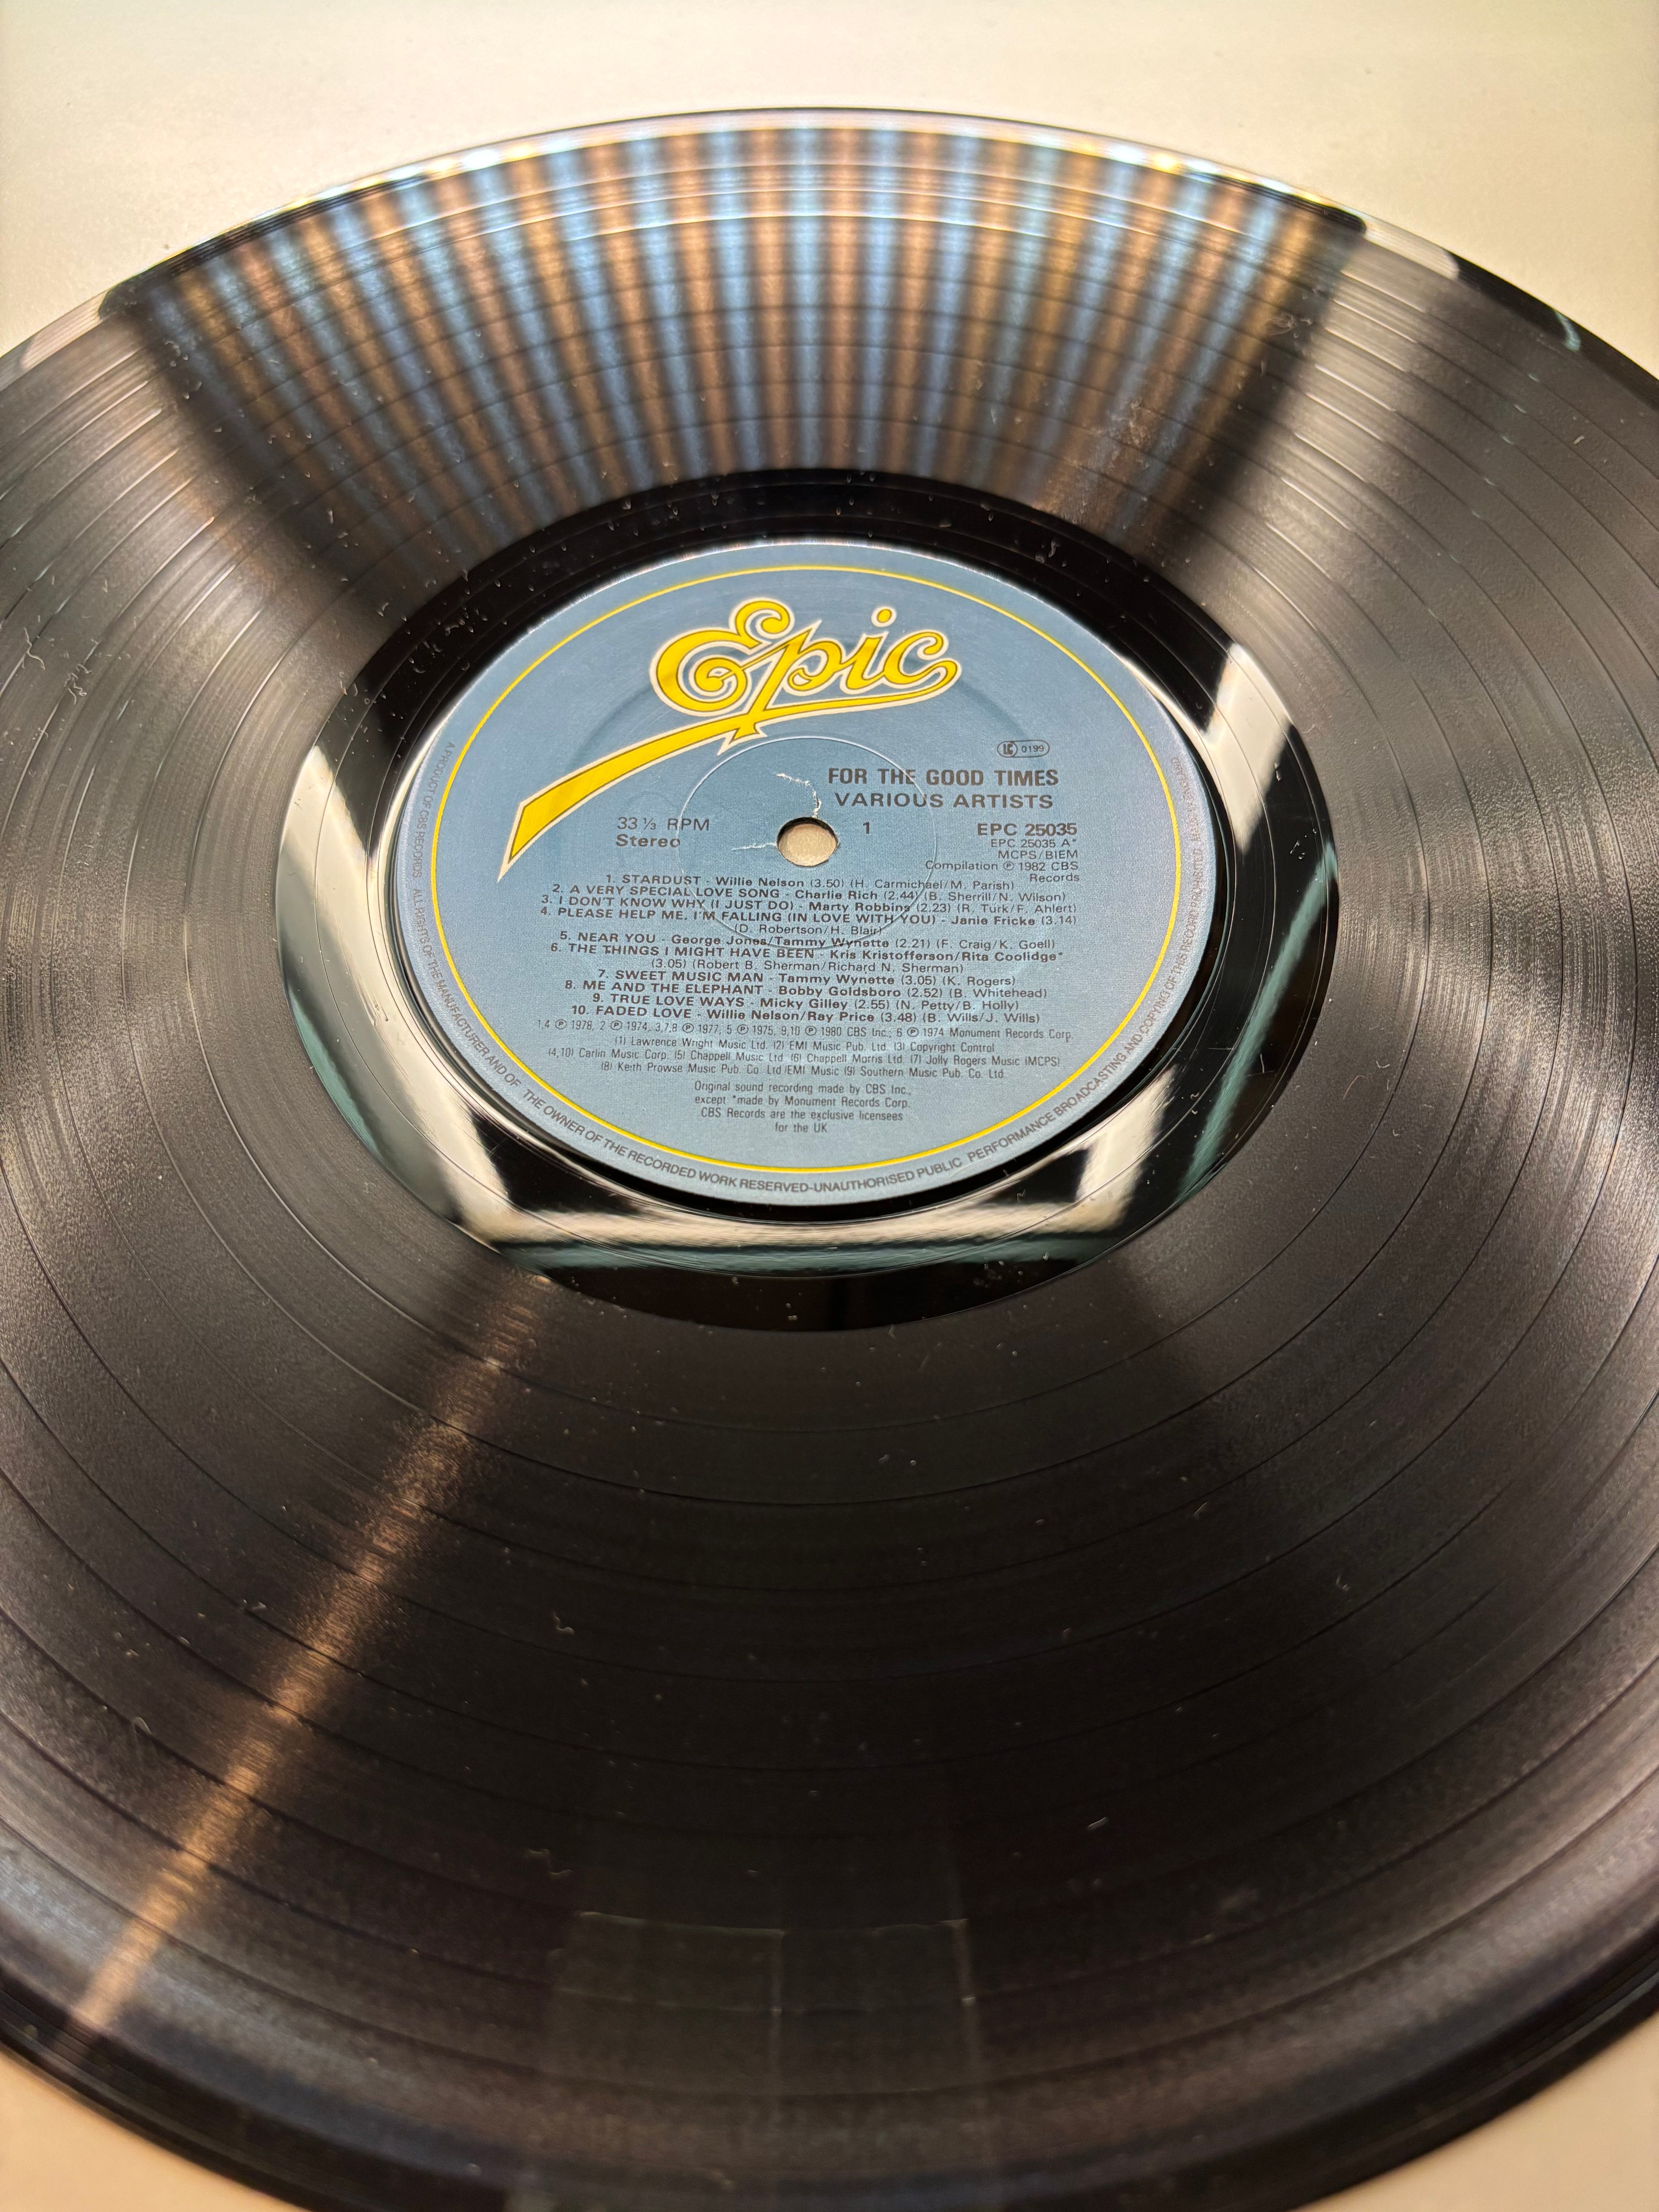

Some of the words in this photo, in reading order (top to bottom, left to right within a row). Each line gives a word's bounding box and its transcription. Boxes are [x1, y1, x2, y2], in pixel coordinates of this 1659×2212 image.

[1021, 745, 1045, 754] 0199
[429, 750, 452, 795] PRODUCT
[829, 768, 867, 785] FOR
[878, 769, 915, 785] THE
[926, 769, 984, 786] GOOD
[995, 769, 1058, 787] TIMES
[422, 795, 434, 812] OF
[835, 793, 944, 807] VARIOUS
[953, 794, 1053, 809] ARTISTS
[667, 818, 710, 831] RPM
[863, 822, 871, 834] 1
[977, 823, 1017, 836] EPC
[1025, 823, 1077, 836] 25035
[616, 834, 681, 848] Stereo
[991, 839, 1017, 848] EPC
[1021, 839, 1056, 848] 25035
[998, 850, 1078, 860] MCPS/BIEM
[925, 861, 998, 871] Compilation
[1019, 861, 1046, 871] 1982
[1051, 861, 1079, 871] CBS
[623, 875, 701, 885] STARDUST
[716, 877, 752, 886] Willie
[758, 878, 804, 887] Nelson
[810, 879, 844, 888] (3.50)
[973, 880, 1014, 890] Parish)
[1030, 873, 1080, 883] Records
[570, 885, 580, 894] A
[587, 886, 624, 895] VERY
[630, 887, 691, 896] SPECIAL
[697, 888, 733, 897] LOVE
[738, 889, 779, 898] SONG
[795, 890, 842, 899] Charlie
[849, 891, 877, 899] Rich
[884, 892, 918, 900] (2.44)
[1019, 893, 1065, 902] Wilson)
[558, 908, 613, 918] PLEASE
[619, 909, 656, 919] HELP
[721, 912, 782, 922] FALLING
[788, 913, 807, 922] (IN
[814, 914, 850, 923] LOVE
[855, 914, 893, 924] WITH
[900, 915, 935, 925] YOU)
[951, 916, 988, 925] Janie
[994, 917, 1035, 926] Fricke
[1042, 916, 1077, 925] (3.14)
[578, 932, 619, 942] NEAR
[626, 934, 656, 943] YOU
[671, 935, 721, 945] George
[727, 936, 826, 947] Jones/Tammy
[832, 938, 889, 948] Wynette
[895, 939, 930, 948] (2.21)
[1019, 940, 1055, 950] Goell)
[423, 945, 435, 960] OF
[569, 944, 597, 953] THE
[603, 945, 659, 955] THINGS
[675, 947, 725, 957] MIGHT
[730, 948, 770, 958] HAVE
[777, 949, 814, 958] BEEN
[830, 950, 856, 959] Kris
[862, 951, 988, 962] Kristofferson/Rita
[428, 958, 444, 983] THE
[435, 978, 489, 1056] MANUFACTURER
[572, 1006, 589, 1015] 10.
[596, 1006, 647, 1016] FADED
[653, 1009, 692, 1018] LOVE
[707, 1010, 745, 1020] Willie
[751, 1011, 833, 1023] Nelson/Ray
[840, 1012, 874, 1021] Price
[880, 1013, 916, 1023] (3.48)
[1005, 1014, 1039, 1023] Wills)
[682, 1039, 713, 1049] Wright
[719, 1040, 746, 1049] Music
[774, 1041, 784, 1049] (2)
[813, 1042, 840, 1051] Music
[894, 1043, 905, 1051] (3)
[910, 1043, 955, 1053] Copyright
[961, 1044, 994, 1052] Control
[1123, 1034, 1144, 1058] AND
[486, 1054, 508, 1076] AND
[503, 1072, 522, 1089] OF
[695, 1082, 730, 1093] Original
[735, 1082, 763, 1092] sound
[769, 1083, 813, 1094] recording
[818, 1084, 844, 1093] made
[849, 1084, 860, 1096] by
[865, 1084, 885, 1094] CBS
[1053, 1052, 1126, 1117] BROADCASTING
[522, 1089, 546, 1109] THE
[695, 1096, 726, 1107] except
[769, 1096, 778, 1106] by
[785, 1097, 836, 1106] Monument
[842, 1097, 880, 1106] Records
[543, 1105, 585, 1136] OWNER
[701, 1108, 721, 1118] CBS
[727, 1109, 765, 1118] Records
[791, 1110, 805, 1119] the
[811, 1111, 854, 1120] exclusive
[859, 1111, 903, 1121] licensees
[775, 1123, 787, 1132] for
[794, 1124, 807, 1132] the
[814, 1123, 827, 1132] UK
[585, 1130, 604, 1143] OF
[967, 1112, 1056, 1163] PERFORMANCE
[602, 1137, 626, 1156] THE
[627, 1149, 696, 1179] RECORDED
[916, 1157, 963, 1179] PUBLIC
[699, 1171, 737, 1188] WORK
